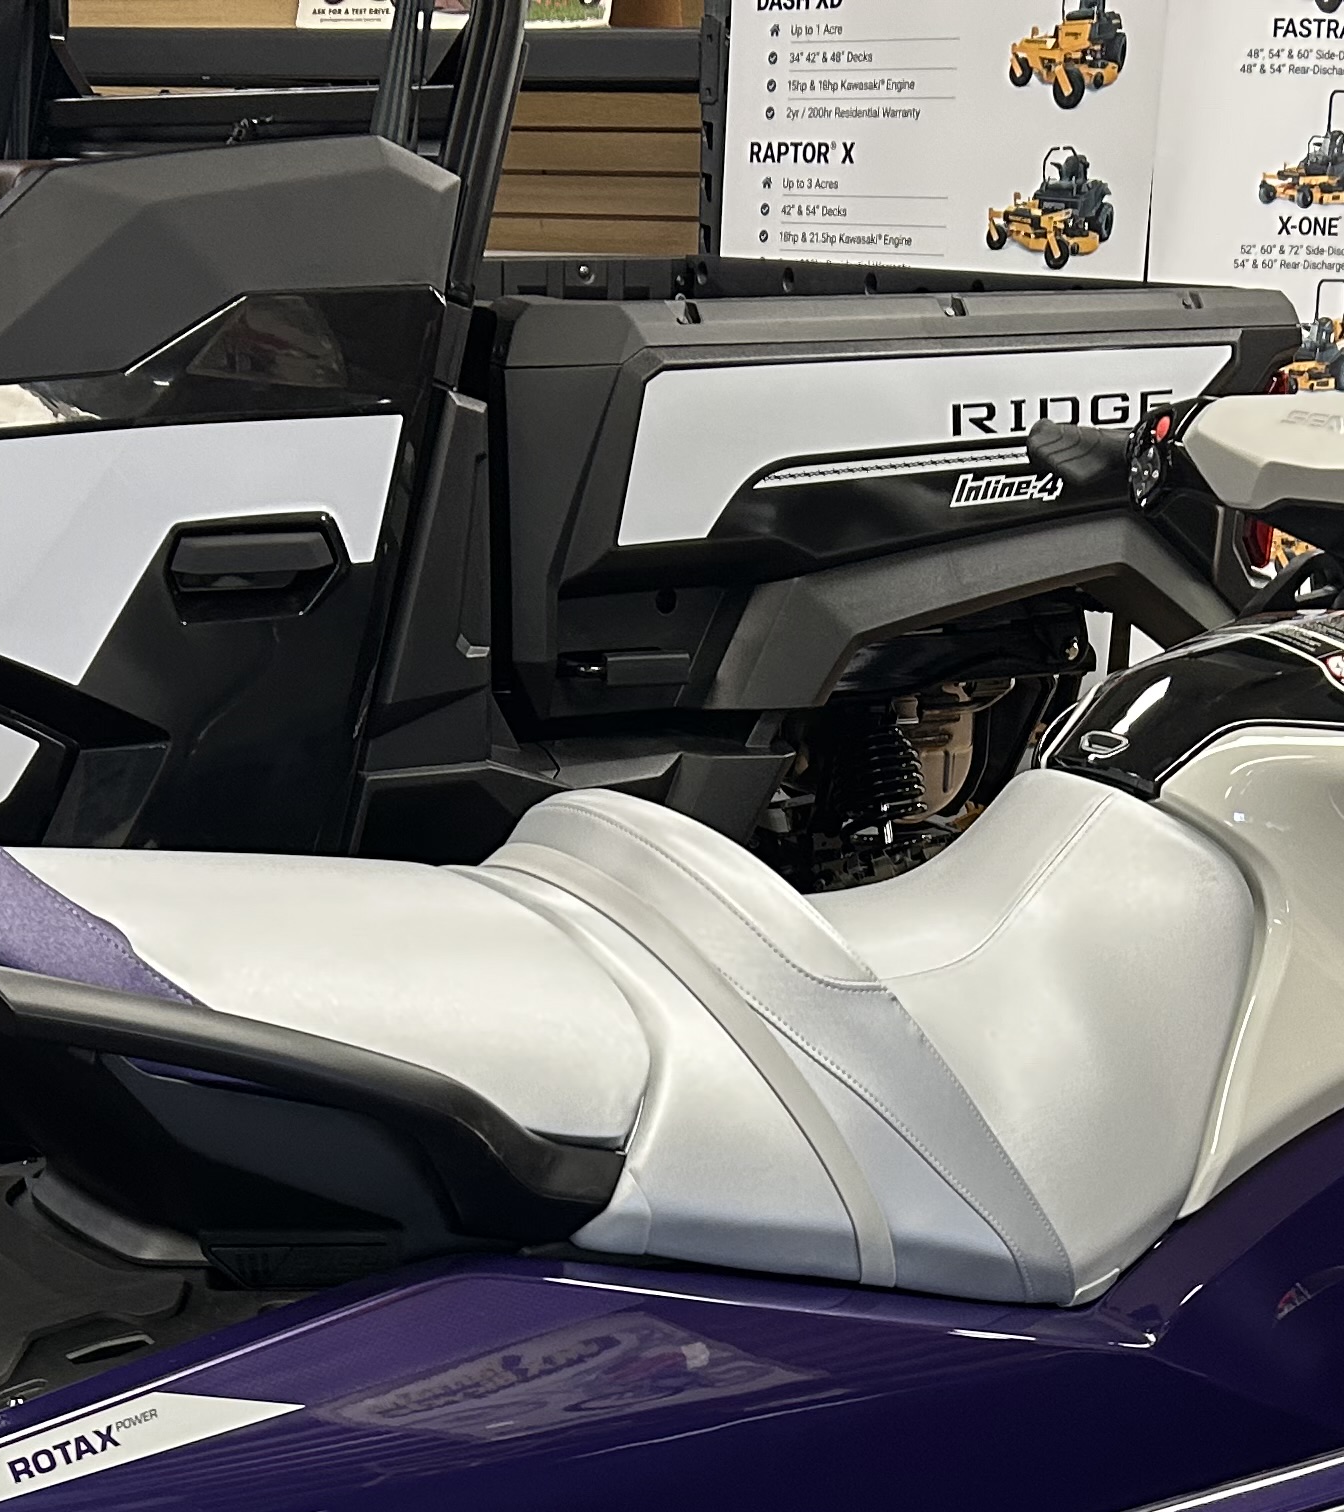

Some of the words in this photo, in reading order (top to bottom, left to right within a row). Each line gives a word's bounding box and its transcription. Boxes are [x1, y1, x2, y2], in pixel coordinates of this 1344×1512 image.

[791, 24, 803, 36] Up
[805, 24, 814, 35] to
[816, 24, 820, 35] 1
[823, 24, 843, 35] Acre
[821, 52, 828, 63] &
[847, 51, 873, 63] Decks
[1287, 49, 1294, 59] &
[1259, 64, 1266, 74] &
[788, 80, 807, 93] 15hp
[809, 80, 816, 91] &
[886, 79, 915, 92] Engine
[786, 107, 799, 119] 2yr
[808, 107, 832, 119] 200hr
[834, 106, 879, 119] Residential
[882, 107, 921, 120] Warranty
[841, 142, 855, 164] X
[782, 178, 793, 191] Up
[796, 178, 804, 189] to
[807, 178, 813, 189] 3
[815, 178, 839, 190] Acres
[797, 205, 803, 216] &
[821, 205, 847, 217] Decks
[801, 232, 806, 243] &
[809, 232, 836, 245] 21.5hp
[883, 234, 912, 248] Engine
[1278, 245, 1285, 255] &
[1252, 259, 1258, 269] &
[952, 389, 1173, 436] RIDGE
[7, 1424, 121, 1484] ROTAX
[115, 1408, 158, 1432] POWER
